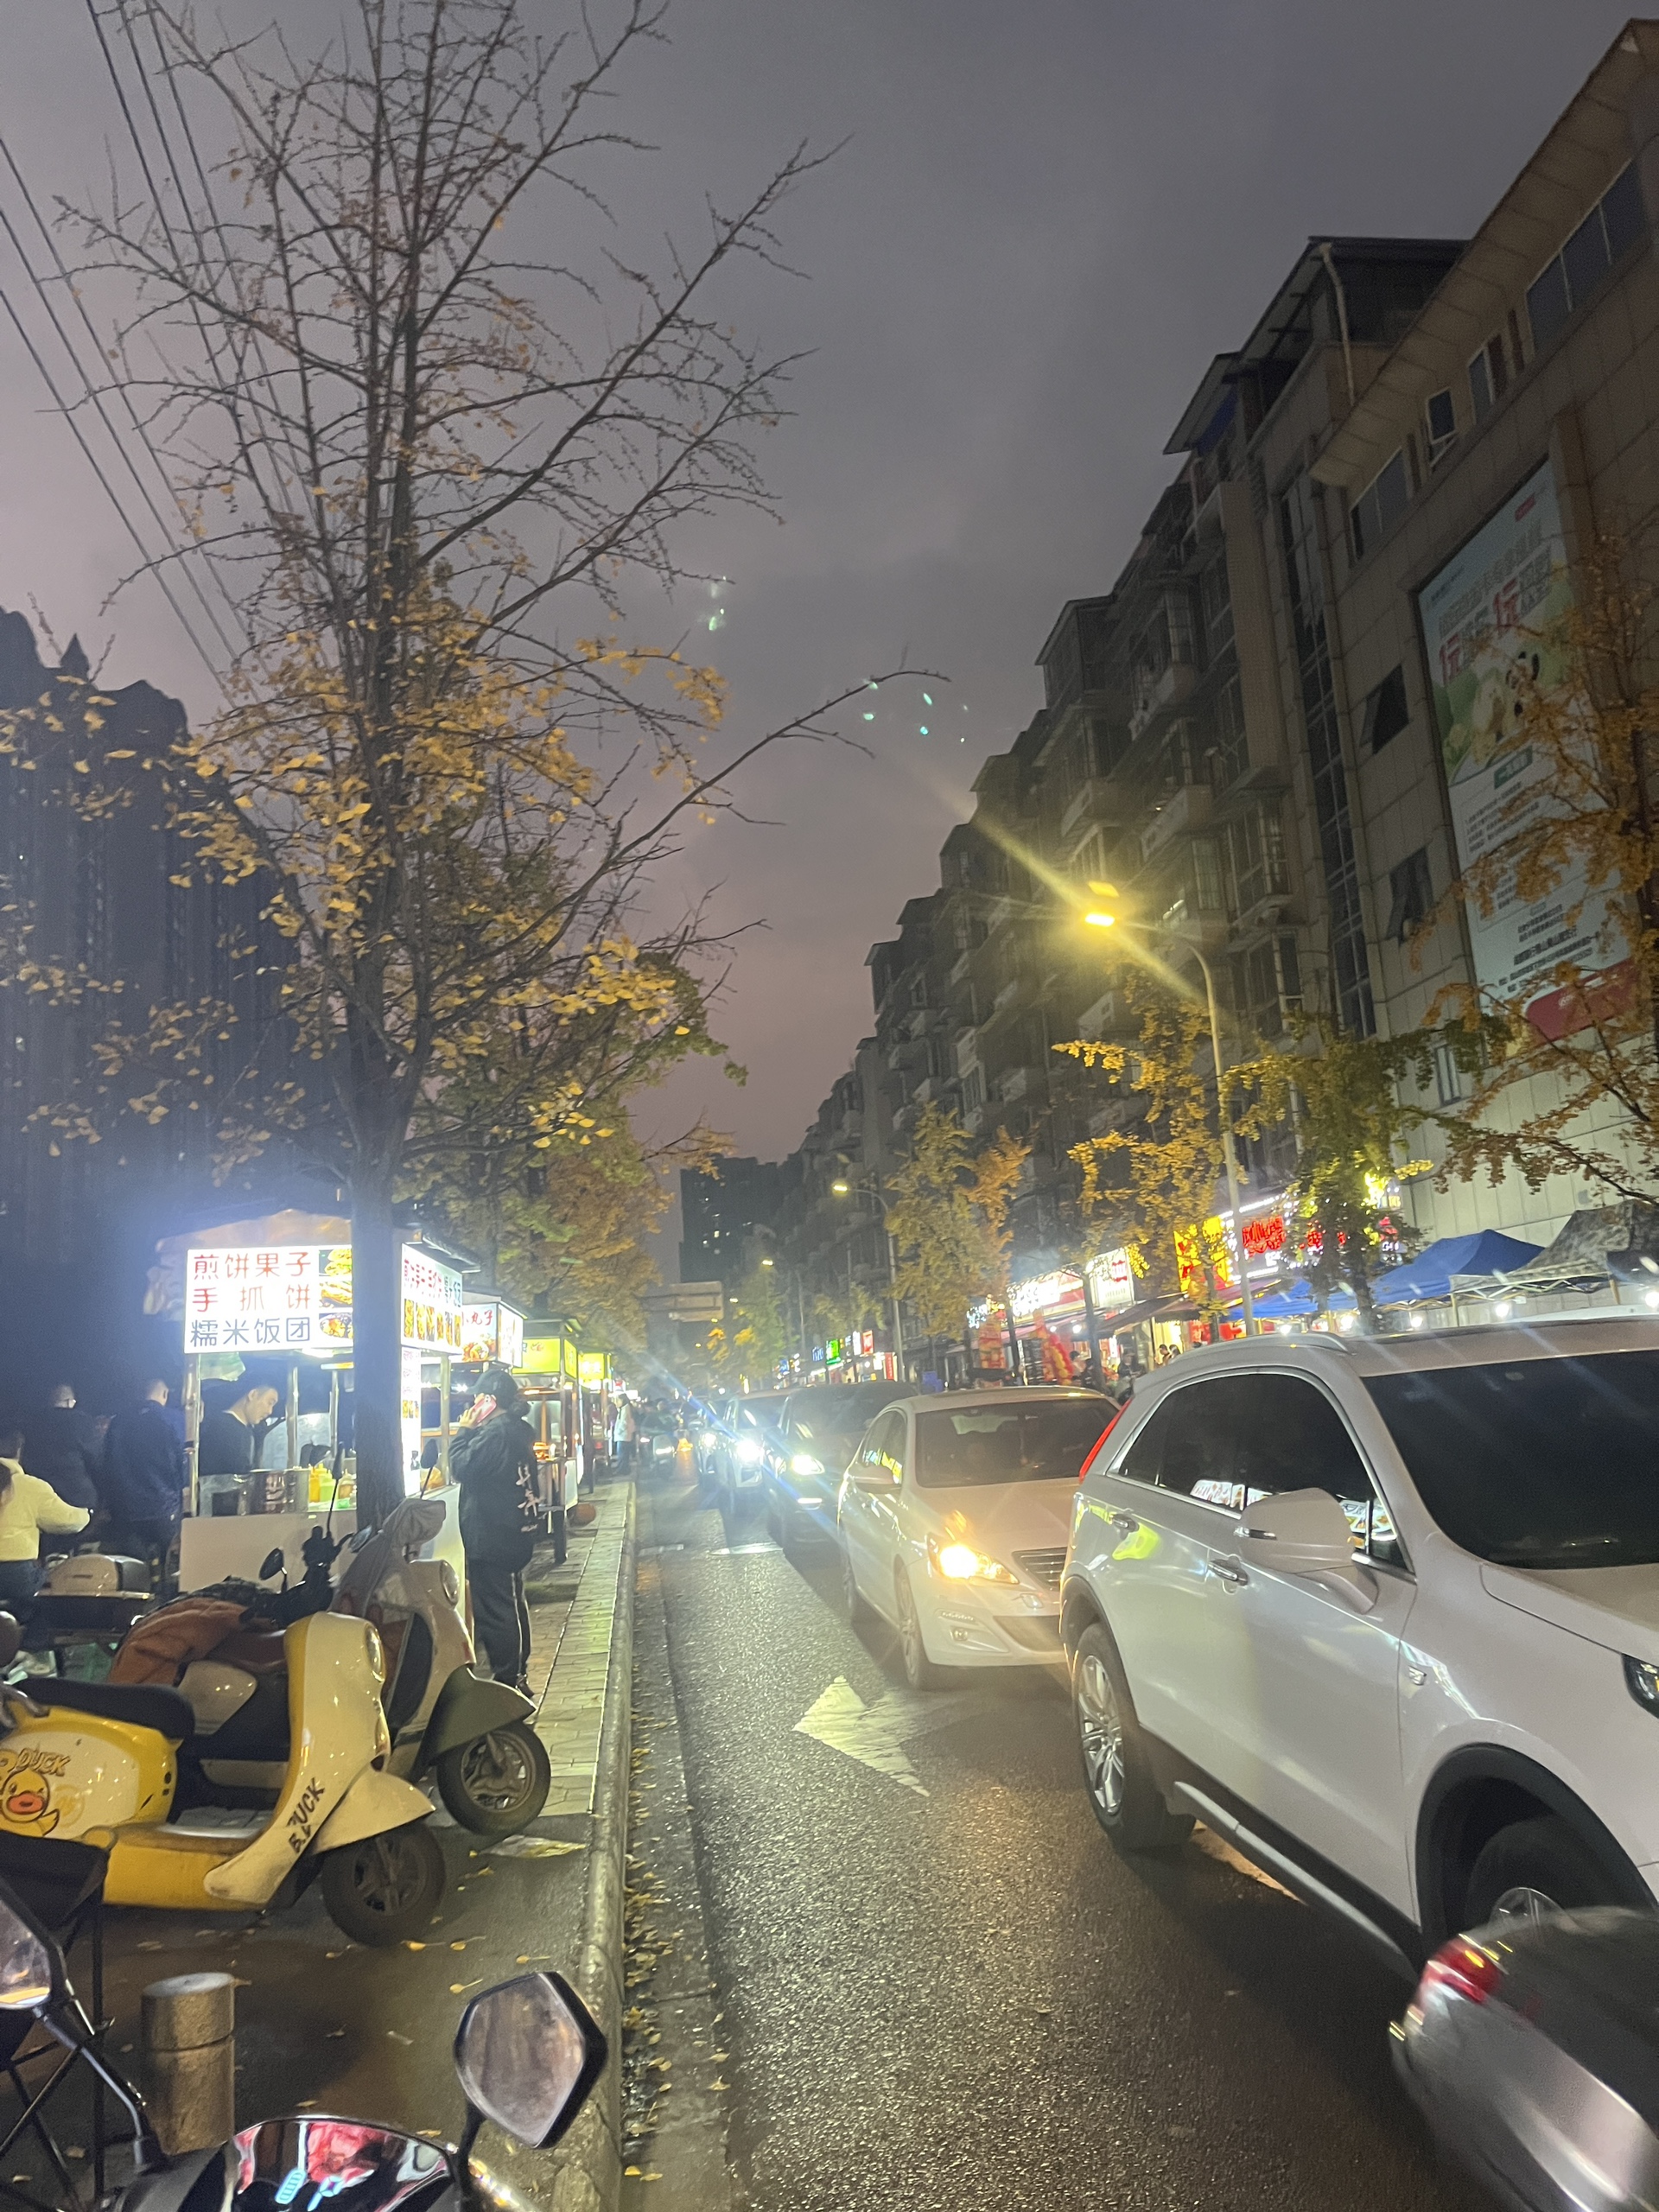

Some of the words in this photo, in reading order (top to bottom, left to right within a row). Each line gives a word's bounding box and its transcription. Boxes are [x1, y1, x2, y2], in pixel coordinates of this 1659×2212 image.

[194, 1251, 311, 1281] 煎饼果子
[192, 1283, 311, 1313] 手抓饼
[190, 1316, 310, 1347] 糯米饭团
